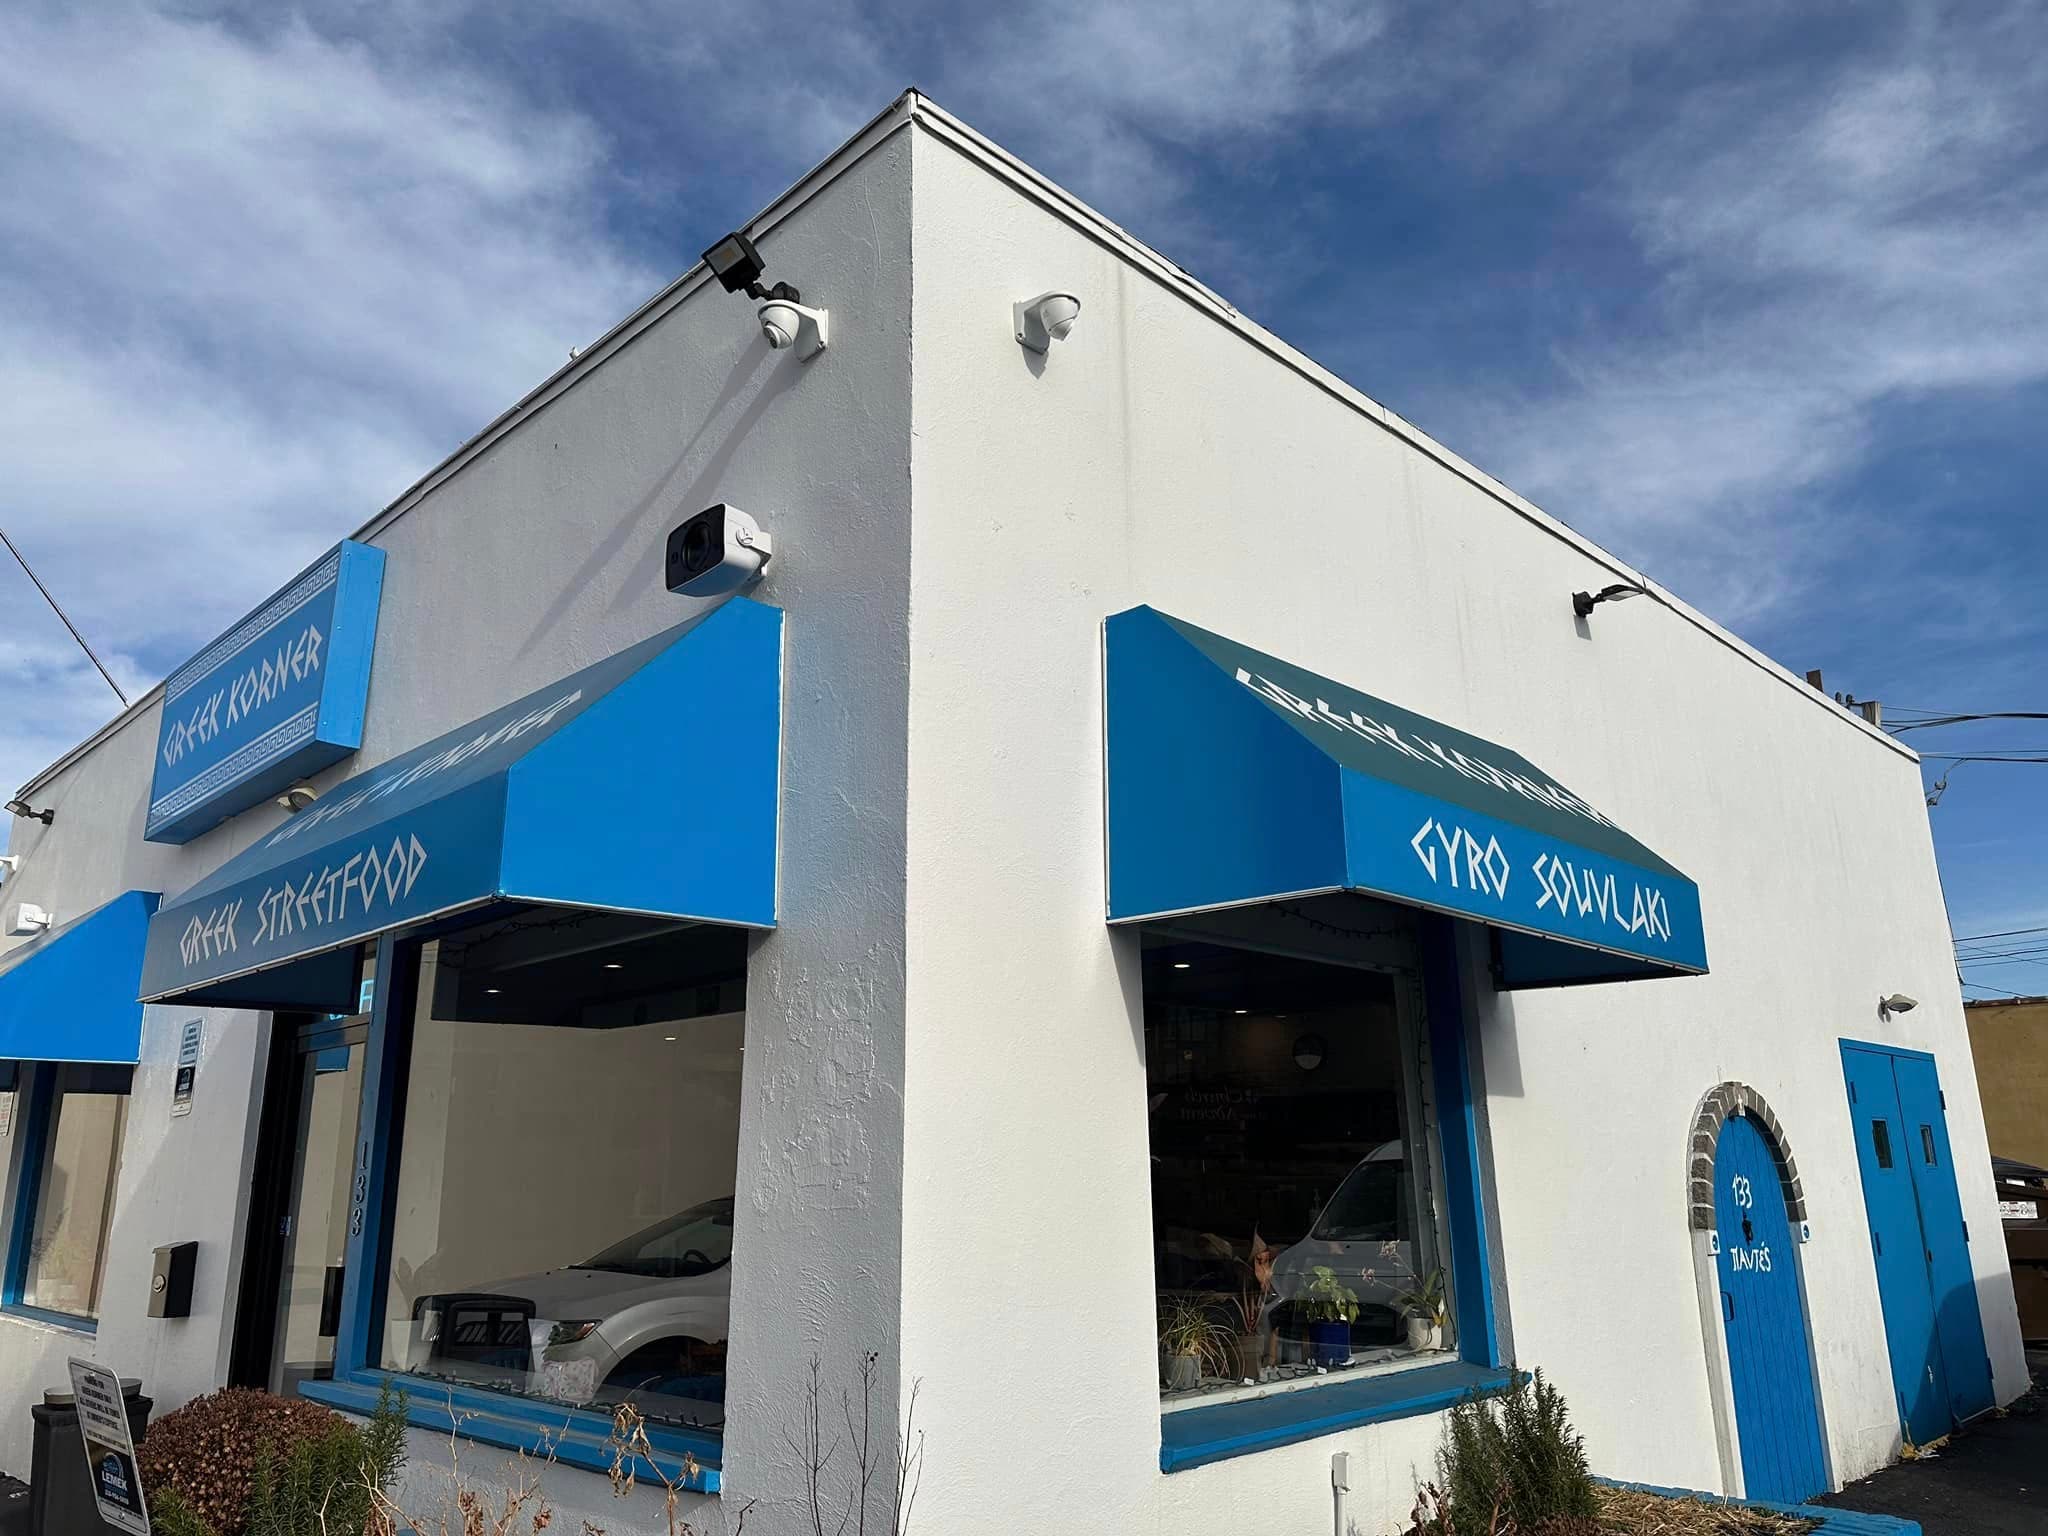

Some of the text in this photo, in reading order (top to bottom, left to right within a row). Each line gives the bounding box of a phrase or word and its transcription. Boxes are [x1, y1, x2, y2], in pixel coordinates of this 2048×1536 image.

[163, 624, 323, 768] GREEK KORNER
[369, 689, 582, 803] KORNER
[1236, 667, 1442, 769] GREEK
[179, 832, 428, 968] GREEK STREETFOOD
[1410, 816, 1672, 942] GYRO SOUVLAKI
[352, 1141, 368, 1237] 133
[1732, 1173, 1753, 1209] 133
